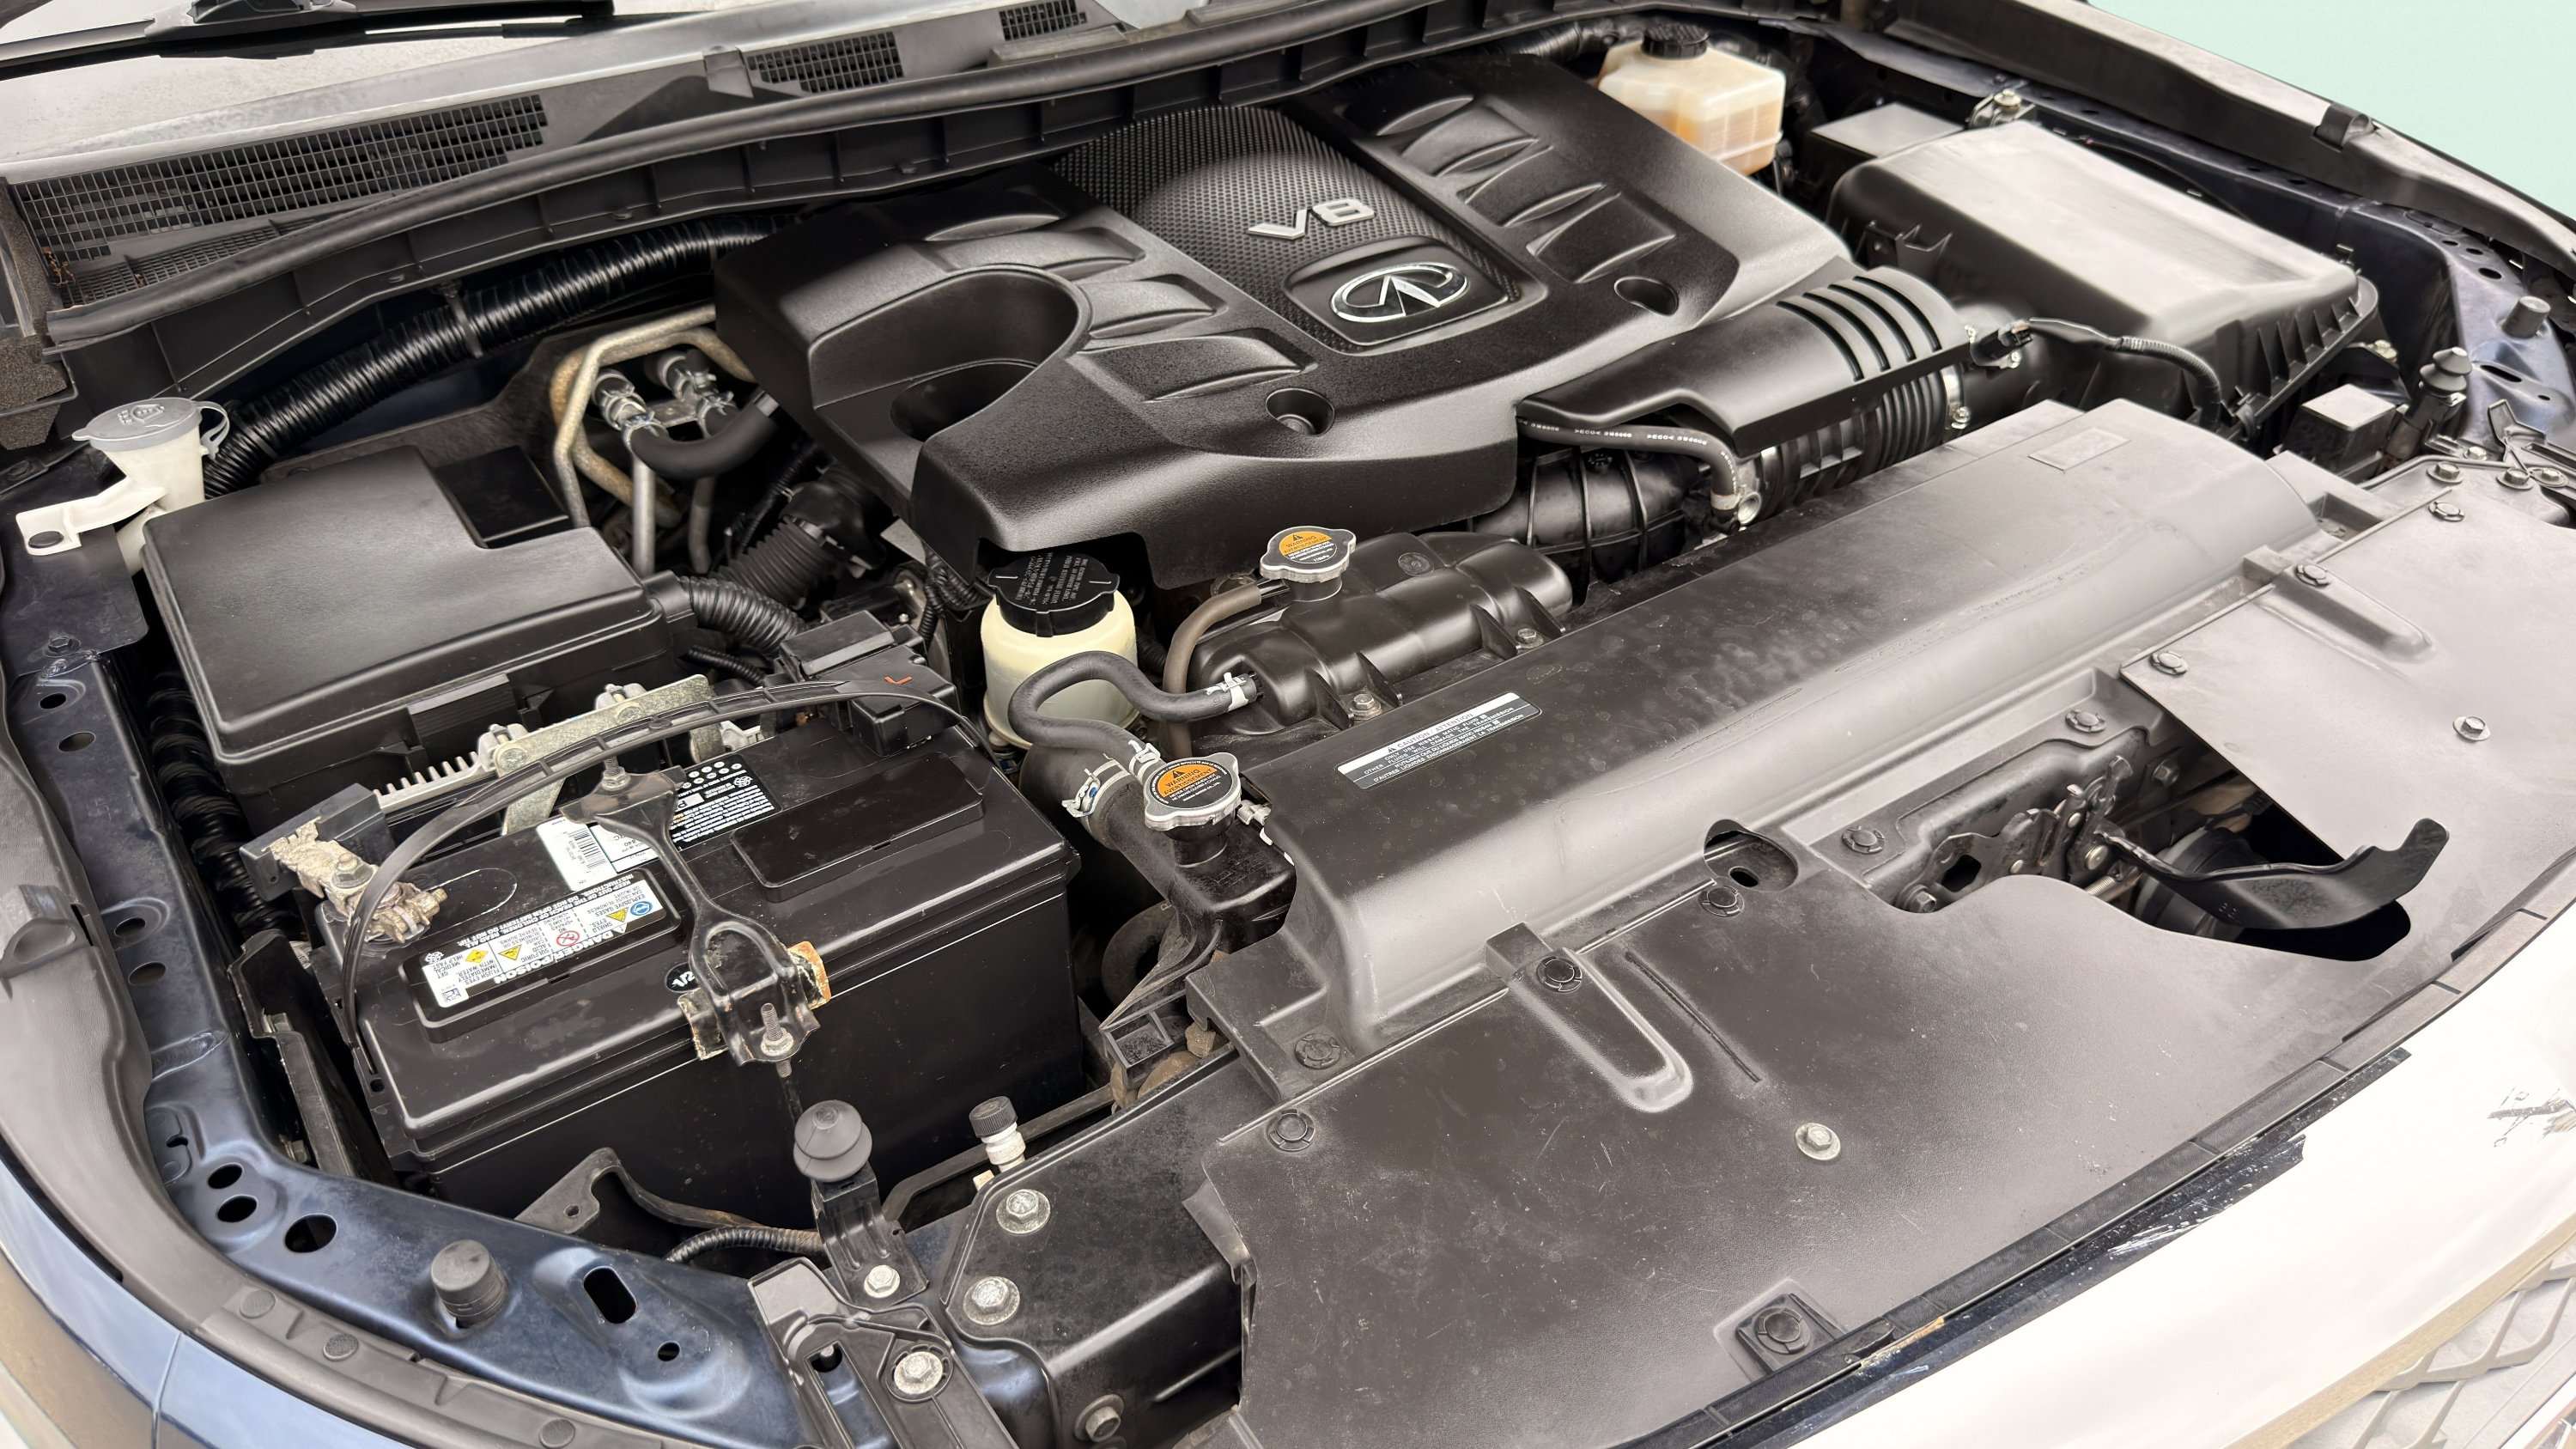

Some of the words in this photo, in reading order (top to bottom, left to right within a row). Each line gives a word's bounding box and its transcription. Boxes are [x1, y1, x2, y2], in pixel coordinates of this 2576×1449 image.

[1246, 198, 1375, 240] V8
[1396, 731, 1431, 747] CAUTION
[1433, 712, 1474, 732] ATTENTION
[1363, 764, 1384, 774] OTHER
[1387, 752, 1408, 764] FLUIDS
[1411, 745, 1427, 753] WILL
[1429, 733, 1455, 745] DAMAGE
[1473, 706, 1515, 726] TRANSMISSION
[1383, 752, 1400, 760] ONLY
[1417, 734, 1440, 746] NISSAN
[1441, 725, 1461, 735] MATIC
[1461, 717, 1479, 727] FLUID
[1372, 768, 1400, 782] D'AUTRES
[1400, 757, 1426, 770] LIQUIDES
[1485, 714, 1525, 732] TRANSMISSION
[1165, 768, 1200, 788] WARNING
[623, 838, 636, 847] 840
[613, 892, 645, 909] EXPLOSIVE
[594, 905, 614, 916] GASES
[592, 921, 612, 933] SHIELD
[519, 947, 550, 963] SULFURIC
[532, 942, 546, 953] ACID
[447, 953, 463, 963] HELP
[478, 958, 494, 967] WITH
[433, 959, 460, 974] MEDICAL
[436, 970, 448, 978] GET
[457, 962, 497, 982] IMMEDIATELY
[480, 967, 500, 978] FLUSH
[464, 975, 480, 985] EYES
